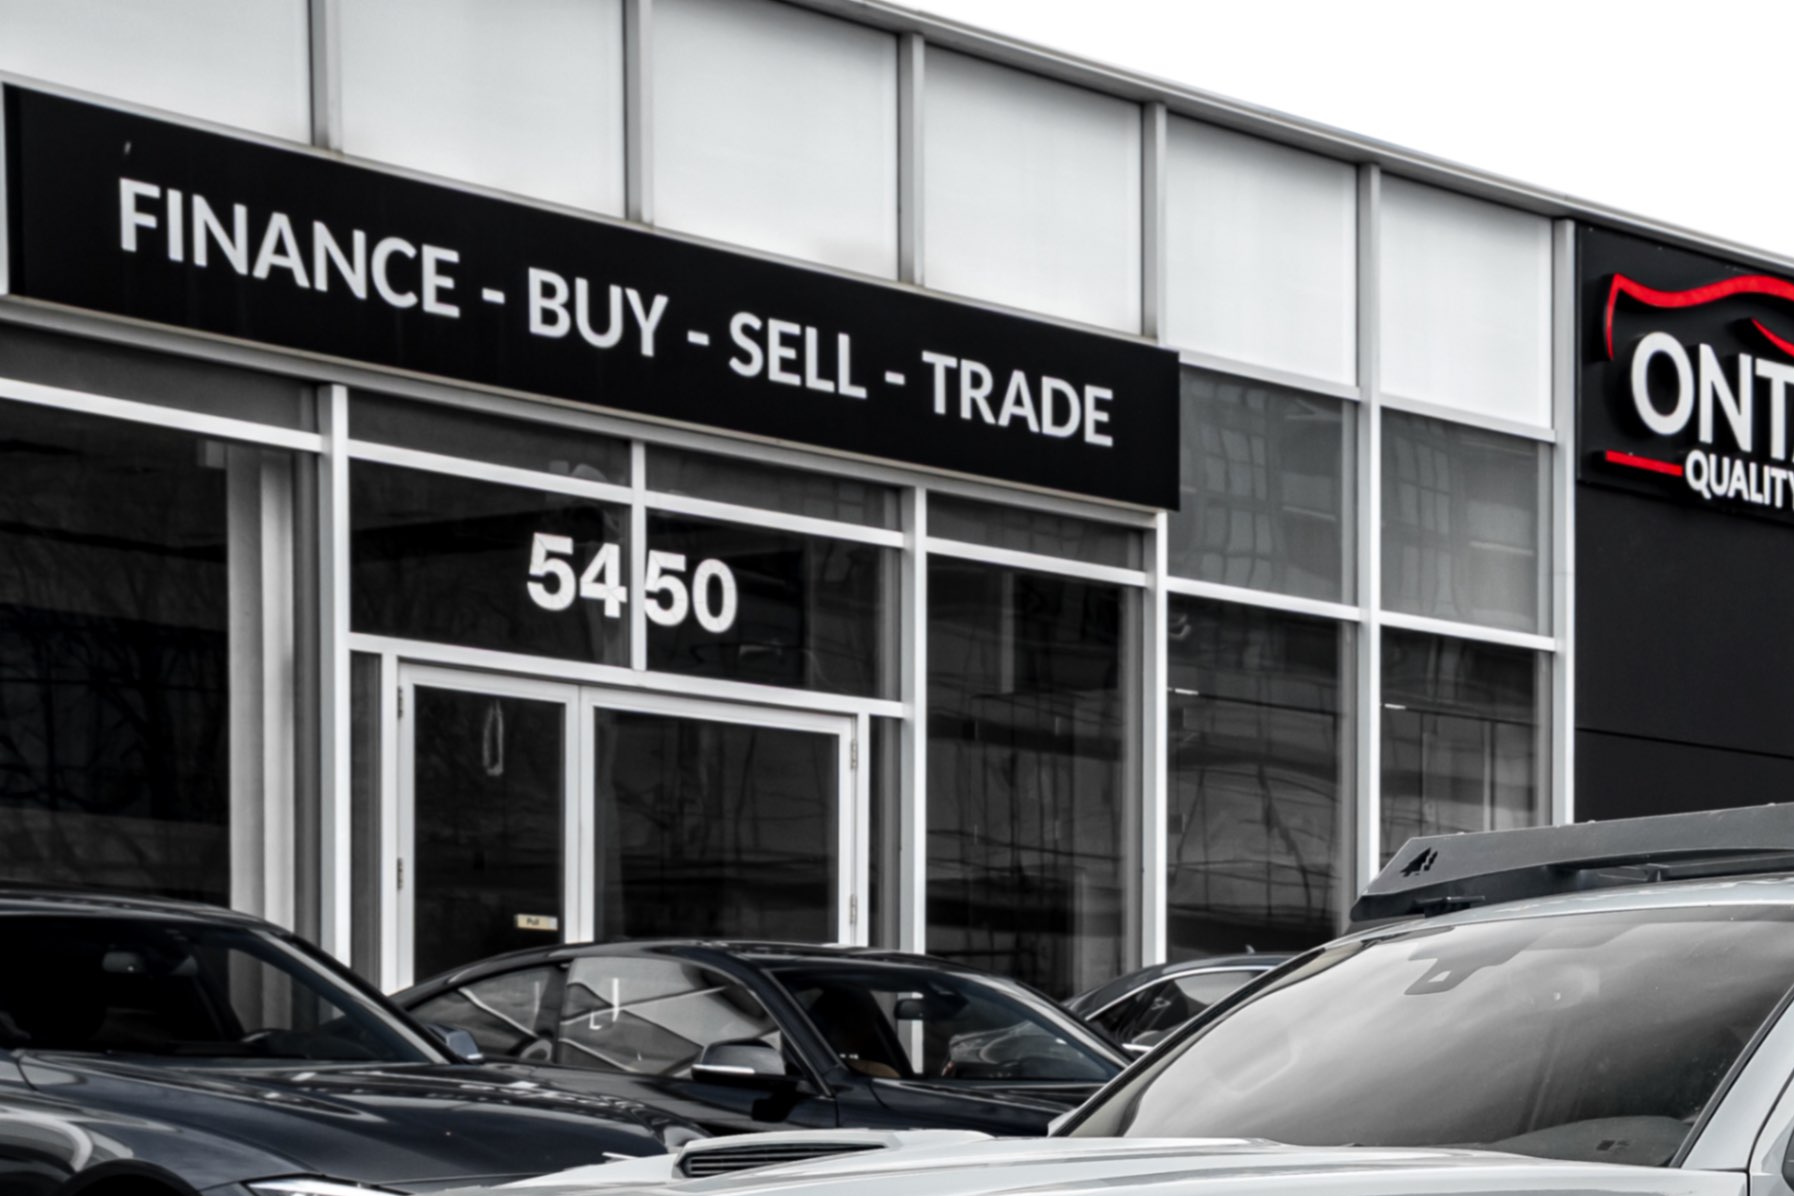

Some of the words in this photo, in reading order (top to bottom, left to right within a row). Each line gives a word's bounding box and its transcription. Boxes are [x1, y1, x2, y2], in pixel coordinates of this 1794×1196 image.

[118, 177, 460, 318] FINANCE
[527, 266, 669, 358] BUY
[728, 311, 867, 400] SELL
[921, 349, 1114, 448] TRADE
[527, 531, 739, 634] 5450
